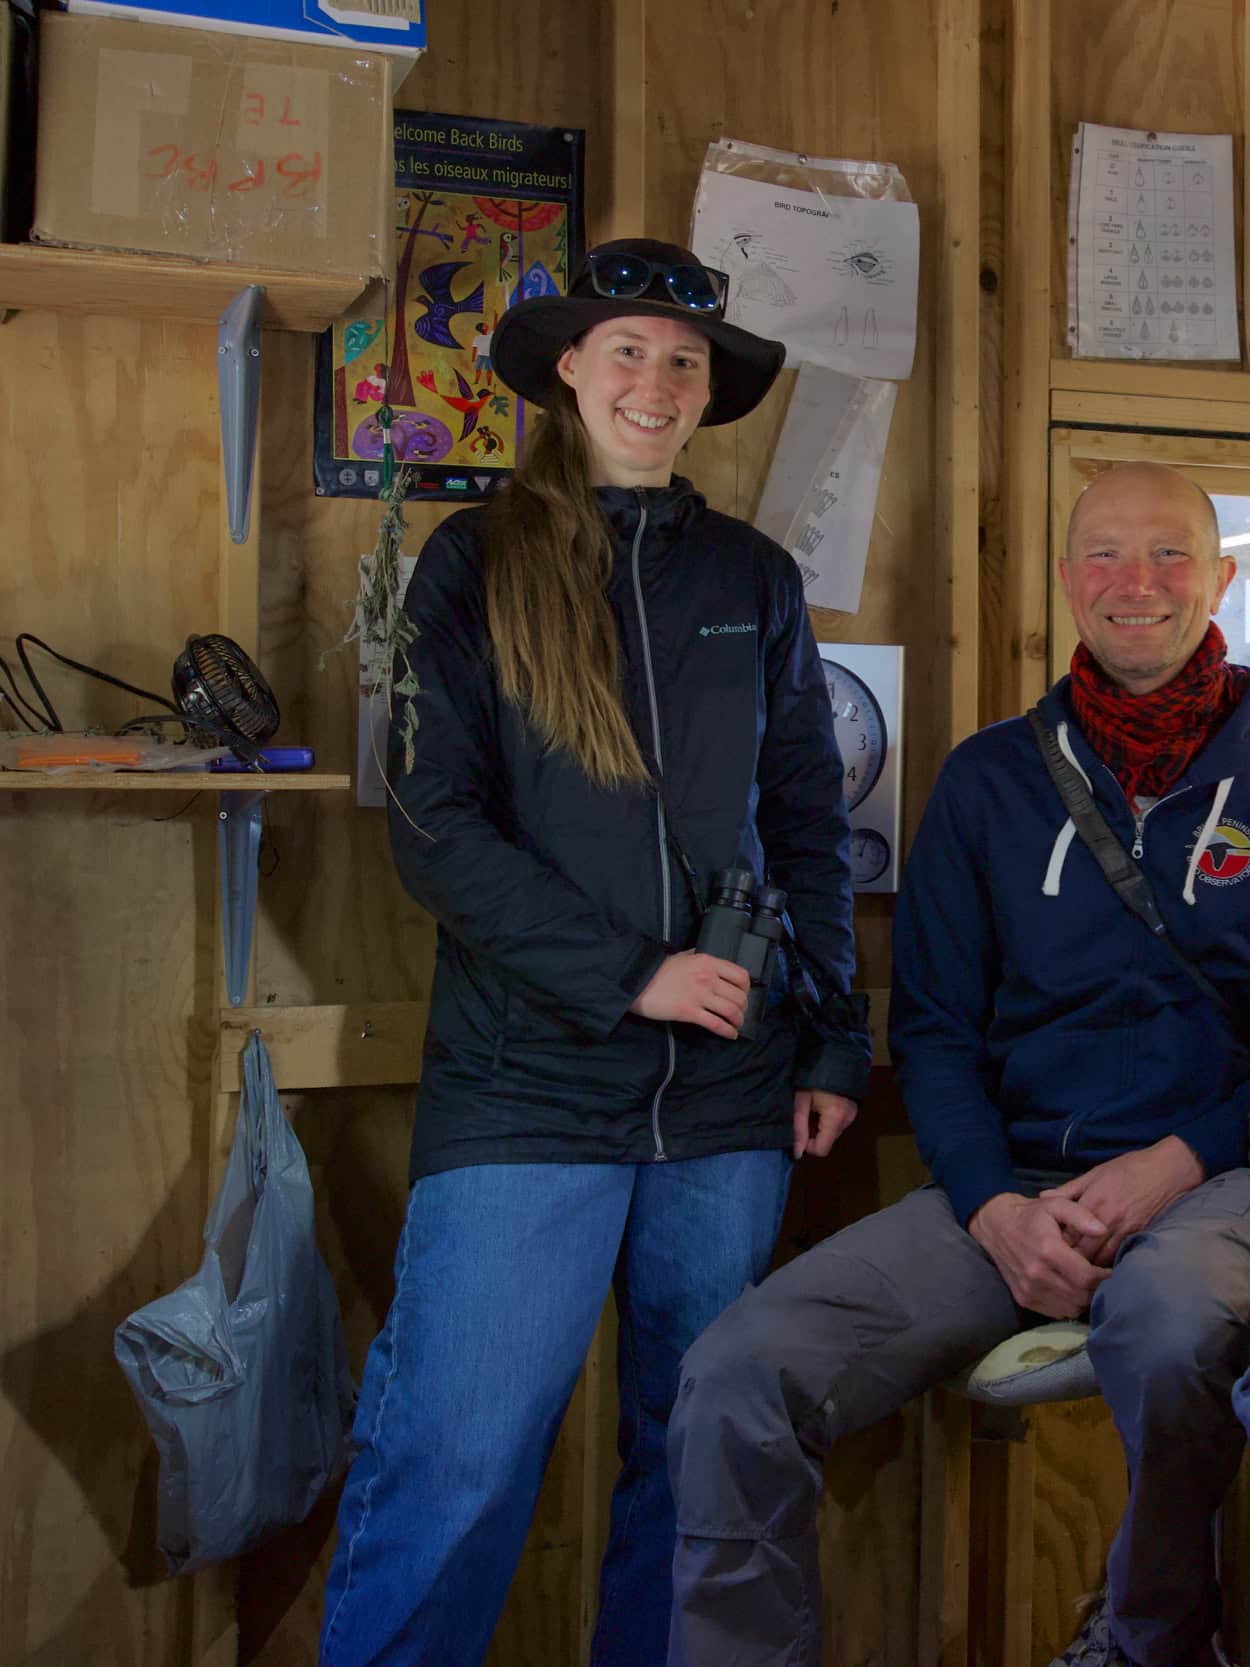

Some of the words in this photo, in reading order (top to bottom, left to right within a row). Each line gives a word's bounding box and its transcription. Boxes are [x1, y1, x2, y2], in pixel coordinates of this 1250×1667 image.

[395, 123, 446, 144] elcome
[450, 128, 485, 149] Back
[489, 134, 524, 153] Birds
[410, 156, 430, 175] les
[434, 161, 488, 181] oiseaux
[493, 167, 573, 190] migrateurs!
[773, 200, 792, 210] BIRD
[710, 622, 757, 635] Columbia
[849, 704, 859, 722] 2
[856, 733, 867, 752] 3
[847, 766, 858, 782] 4
